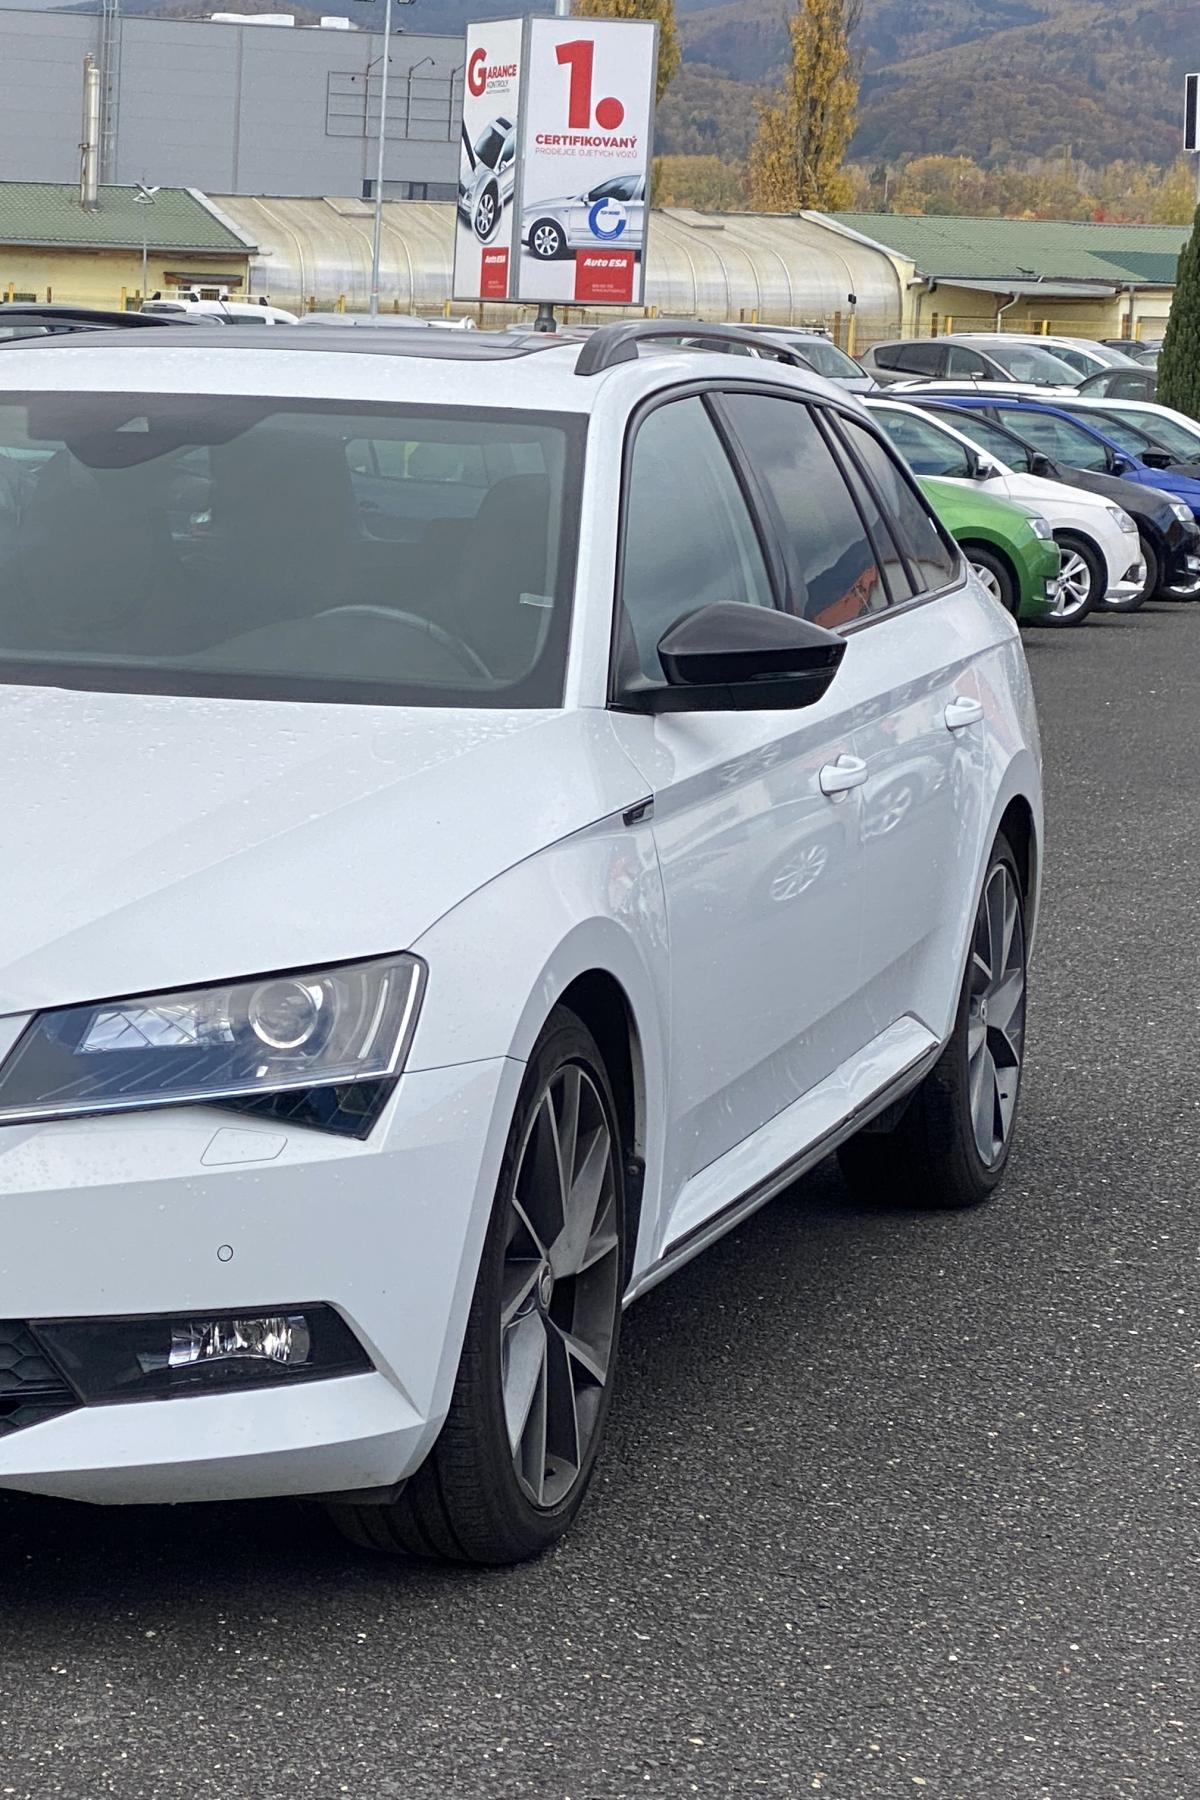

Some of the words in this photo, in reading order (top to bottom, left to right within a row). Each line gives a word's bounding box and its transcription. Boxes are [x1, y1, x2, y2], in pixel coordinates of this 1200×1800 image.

[468, 48, 517, 97] GARANCE
[535, 134, 637, 148] CERTIFIKOVANÝ
[583, 258, 608, 267] Auto
[608, 259, 628, 268] ESA
